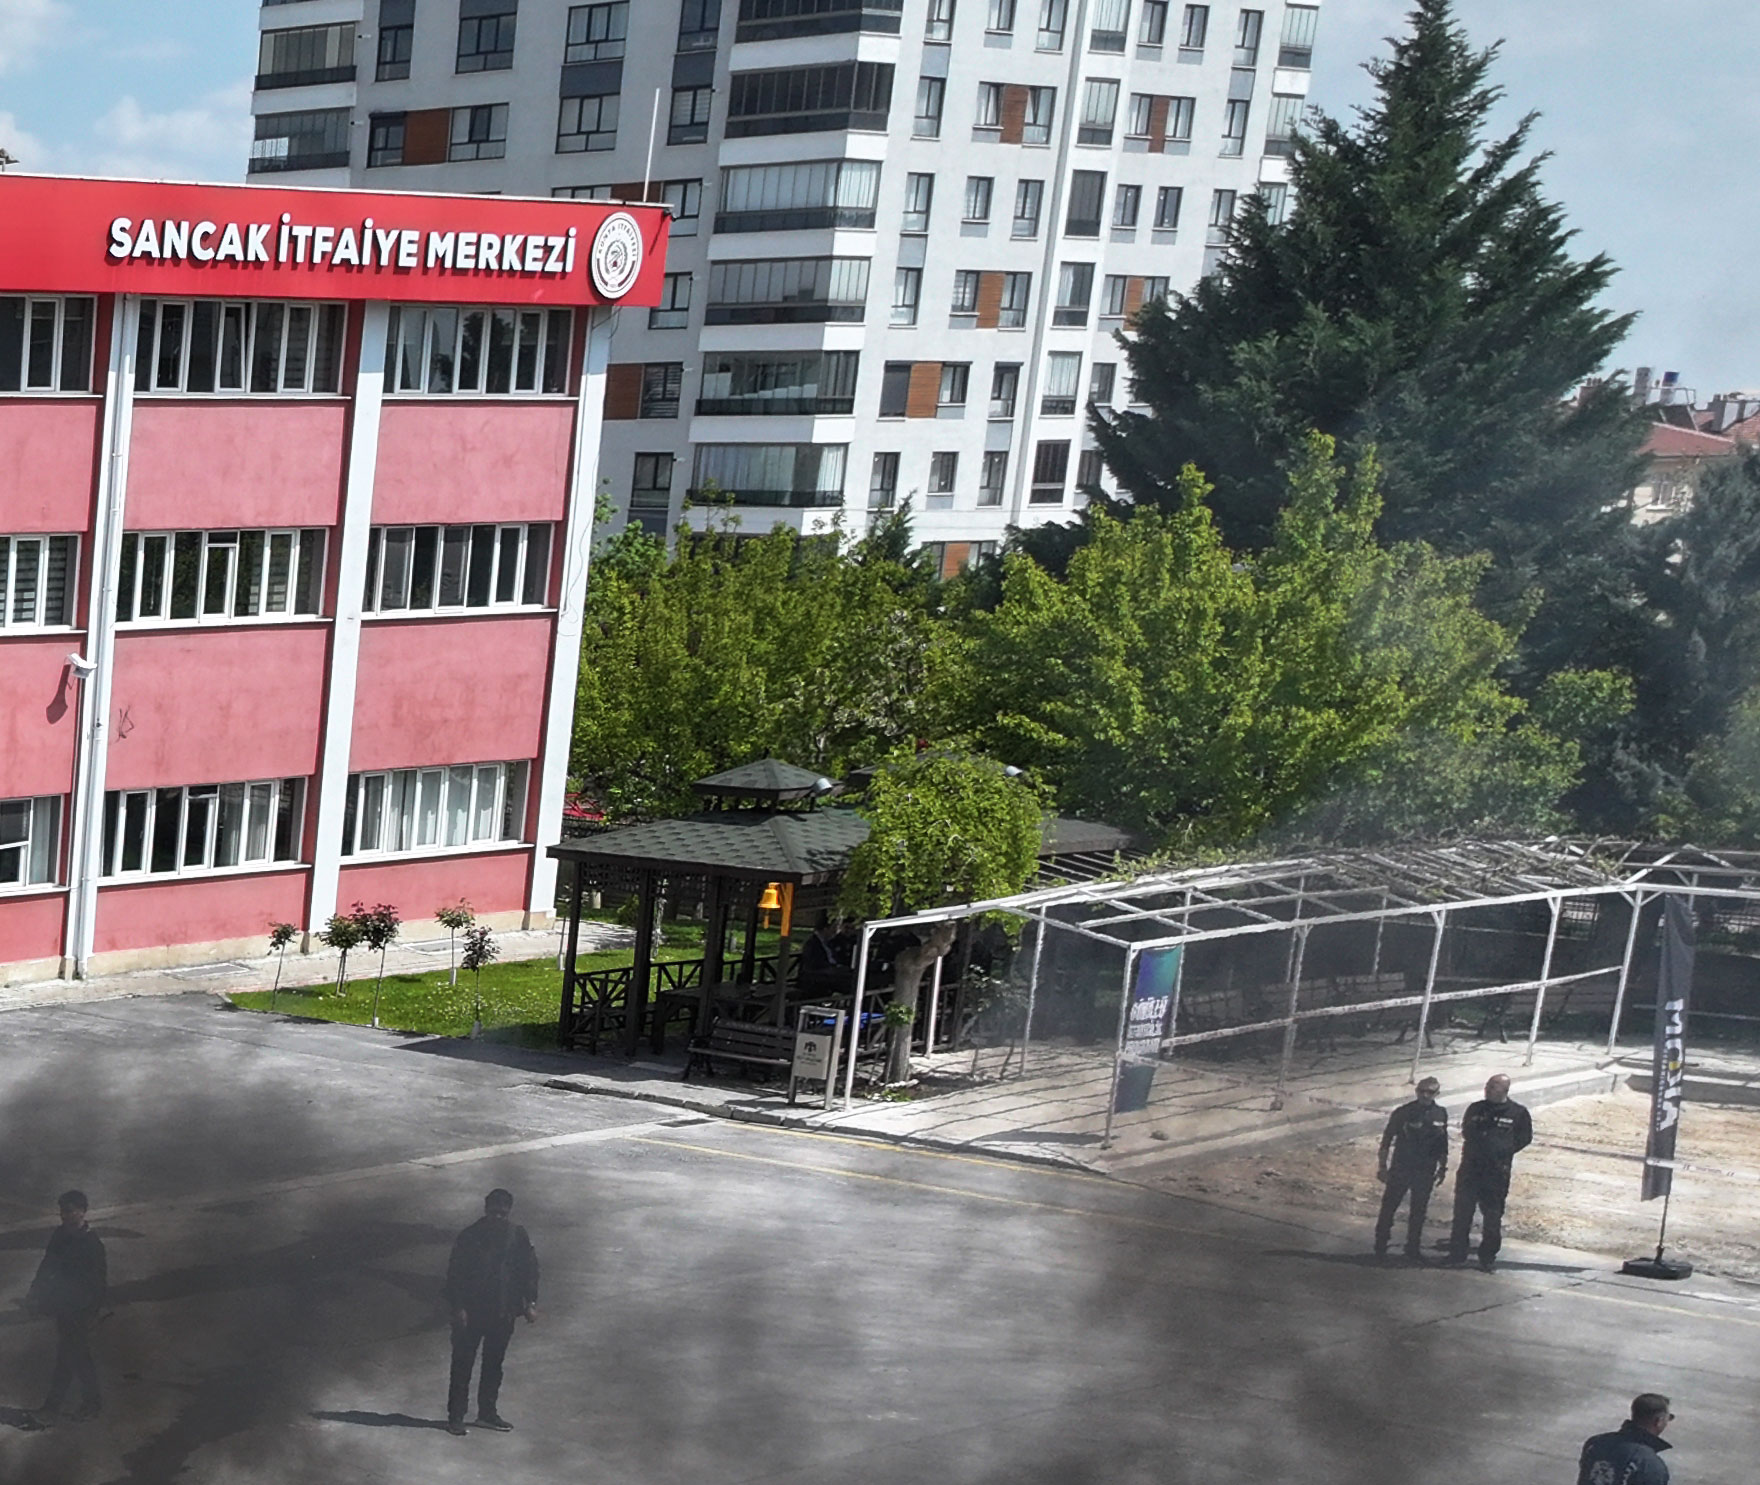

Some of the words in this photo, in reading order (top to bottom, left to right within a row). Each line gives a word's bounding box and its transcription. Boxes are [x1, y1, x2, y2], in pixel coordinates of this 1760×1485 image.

[110, 218, 270, 262] SANCAK
[279, 213, 421, 267] İTFAİYE
[427, 228, 576, 272] MERKEZİ
